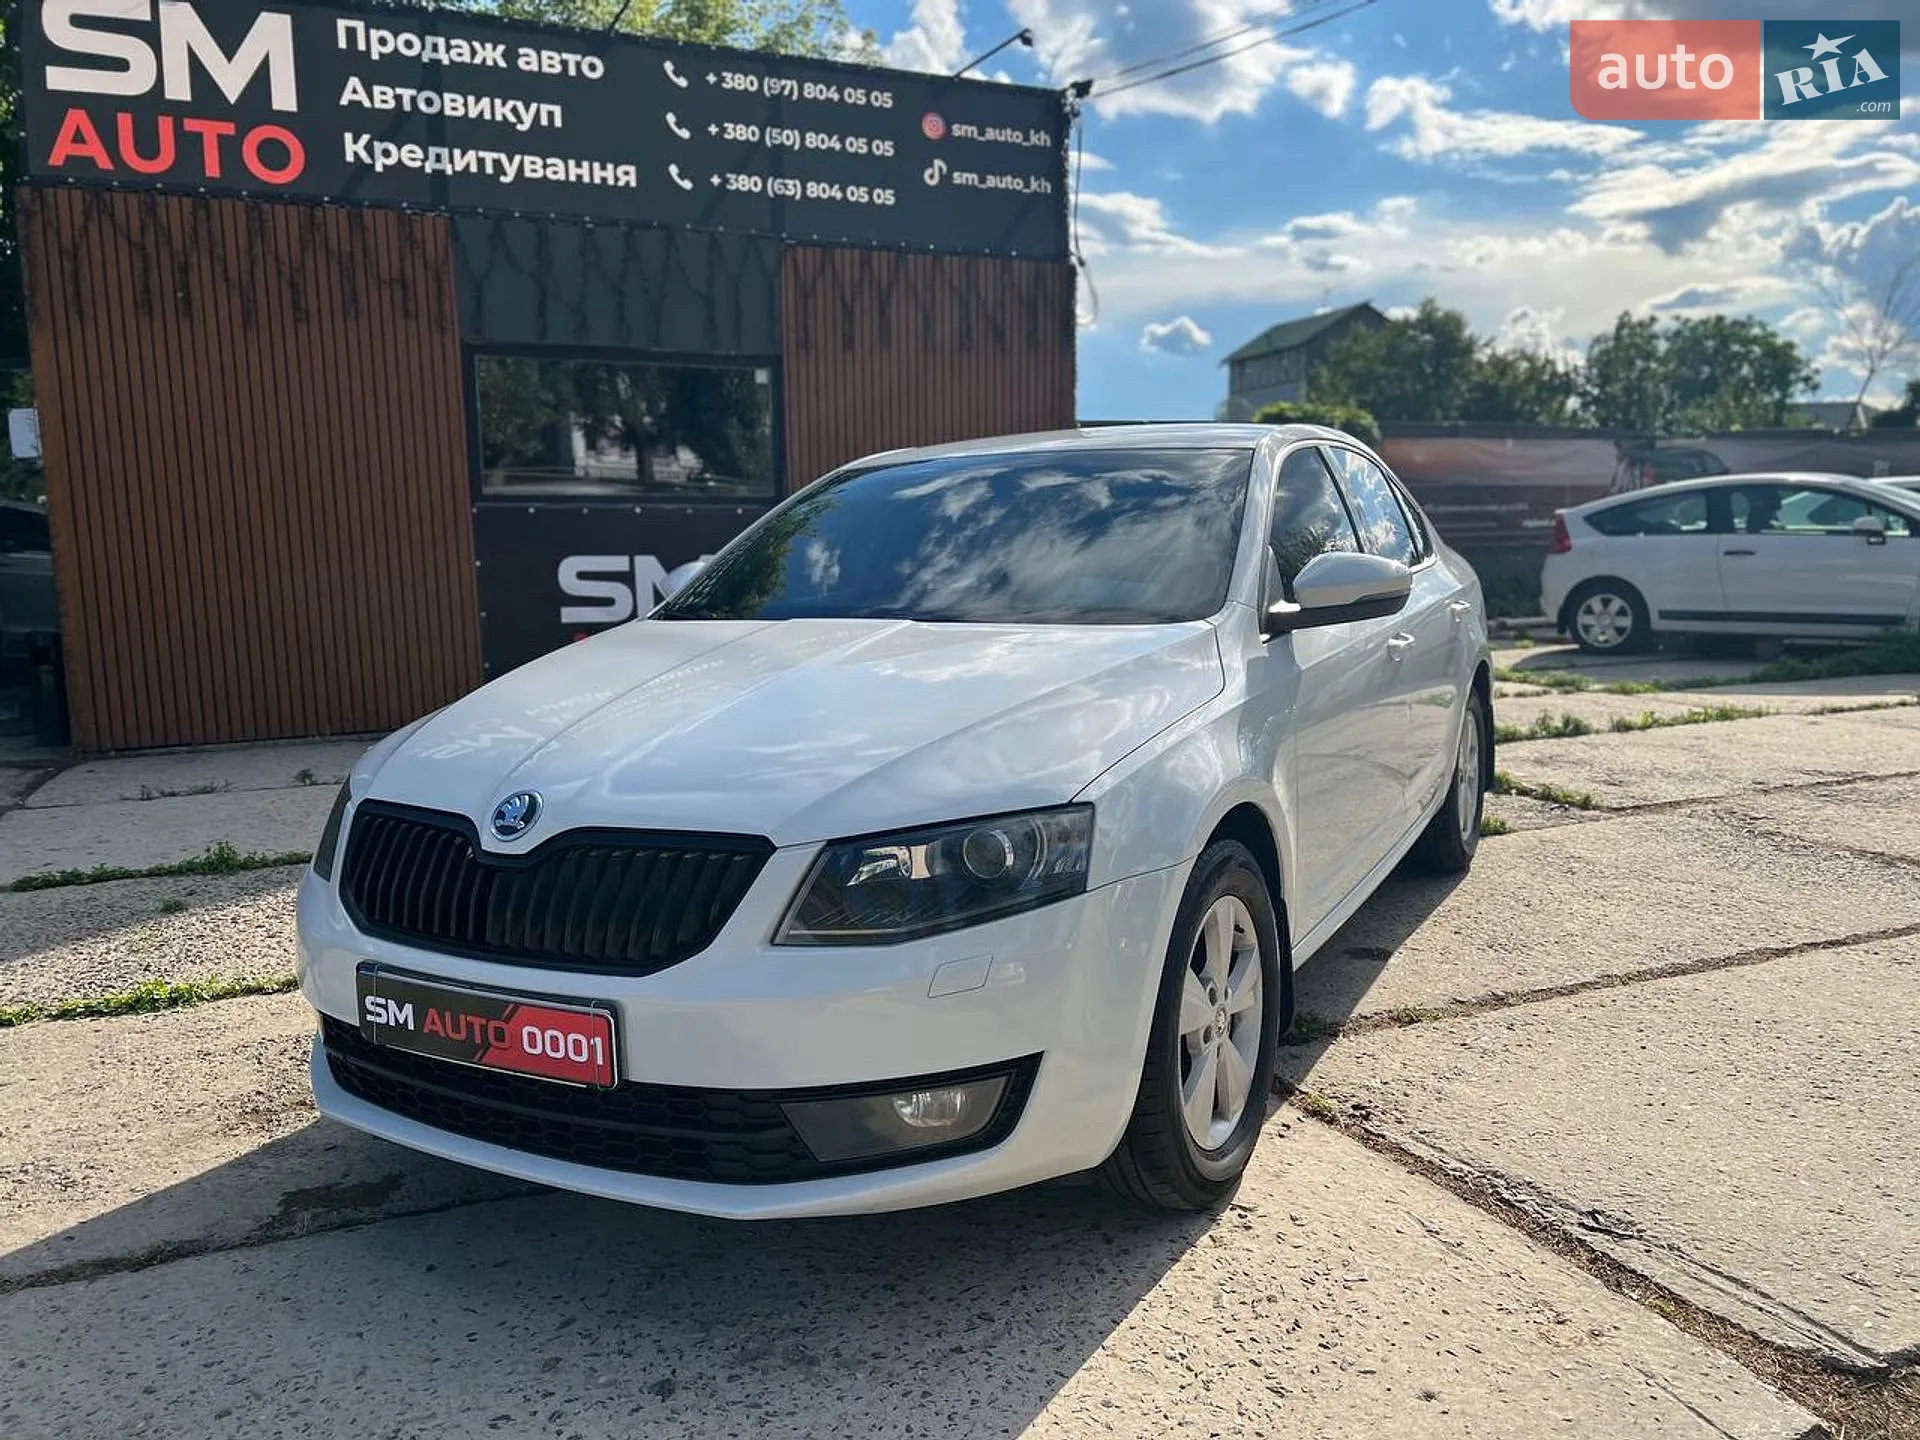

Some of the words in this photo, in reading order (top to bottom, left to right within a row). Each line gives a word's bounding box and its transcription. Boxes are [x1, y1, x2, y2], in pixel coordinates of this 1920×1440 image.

[41, 0, 298, 112] SM
[336, 18, 508, 68] Продаж
[517, 46, 605, 80] авто
[339, 75, 563, 130] Автовикуп
[721, 72, 758, 92] 380
[763, 76, 799, 101] (97)
[803, 82, 840, 102] 804
[844, 87, 867, 105] 05
[870, 91, 893, 108] 05
[47, 107, 307, 185] AUTO
[343, 131, 638, 188] Кредитування
[723, 122, 760, 142] 380
[765, 126, 800, 150] (50)
[805, 131, 842, 151] 804
[845, 136, 868, 154] 05
[872, 140, 895, 157] 05
[951, 122, 1051, 147] sm_auto_kh
[725, 173, 762, 193] 380
[767, 176, 801, 200] (63)
[806, 181, 843, 200] 804
[846, 186, 869, 204] 05
[873, 189, 896, 206] 05
[952, 169, 1052, 194] sm_auto_kh
[364, 995, 414, 1031] SM
[423, 1007, 512, 1049] AUTO
[521, 1025, 603, 1066] 0001
